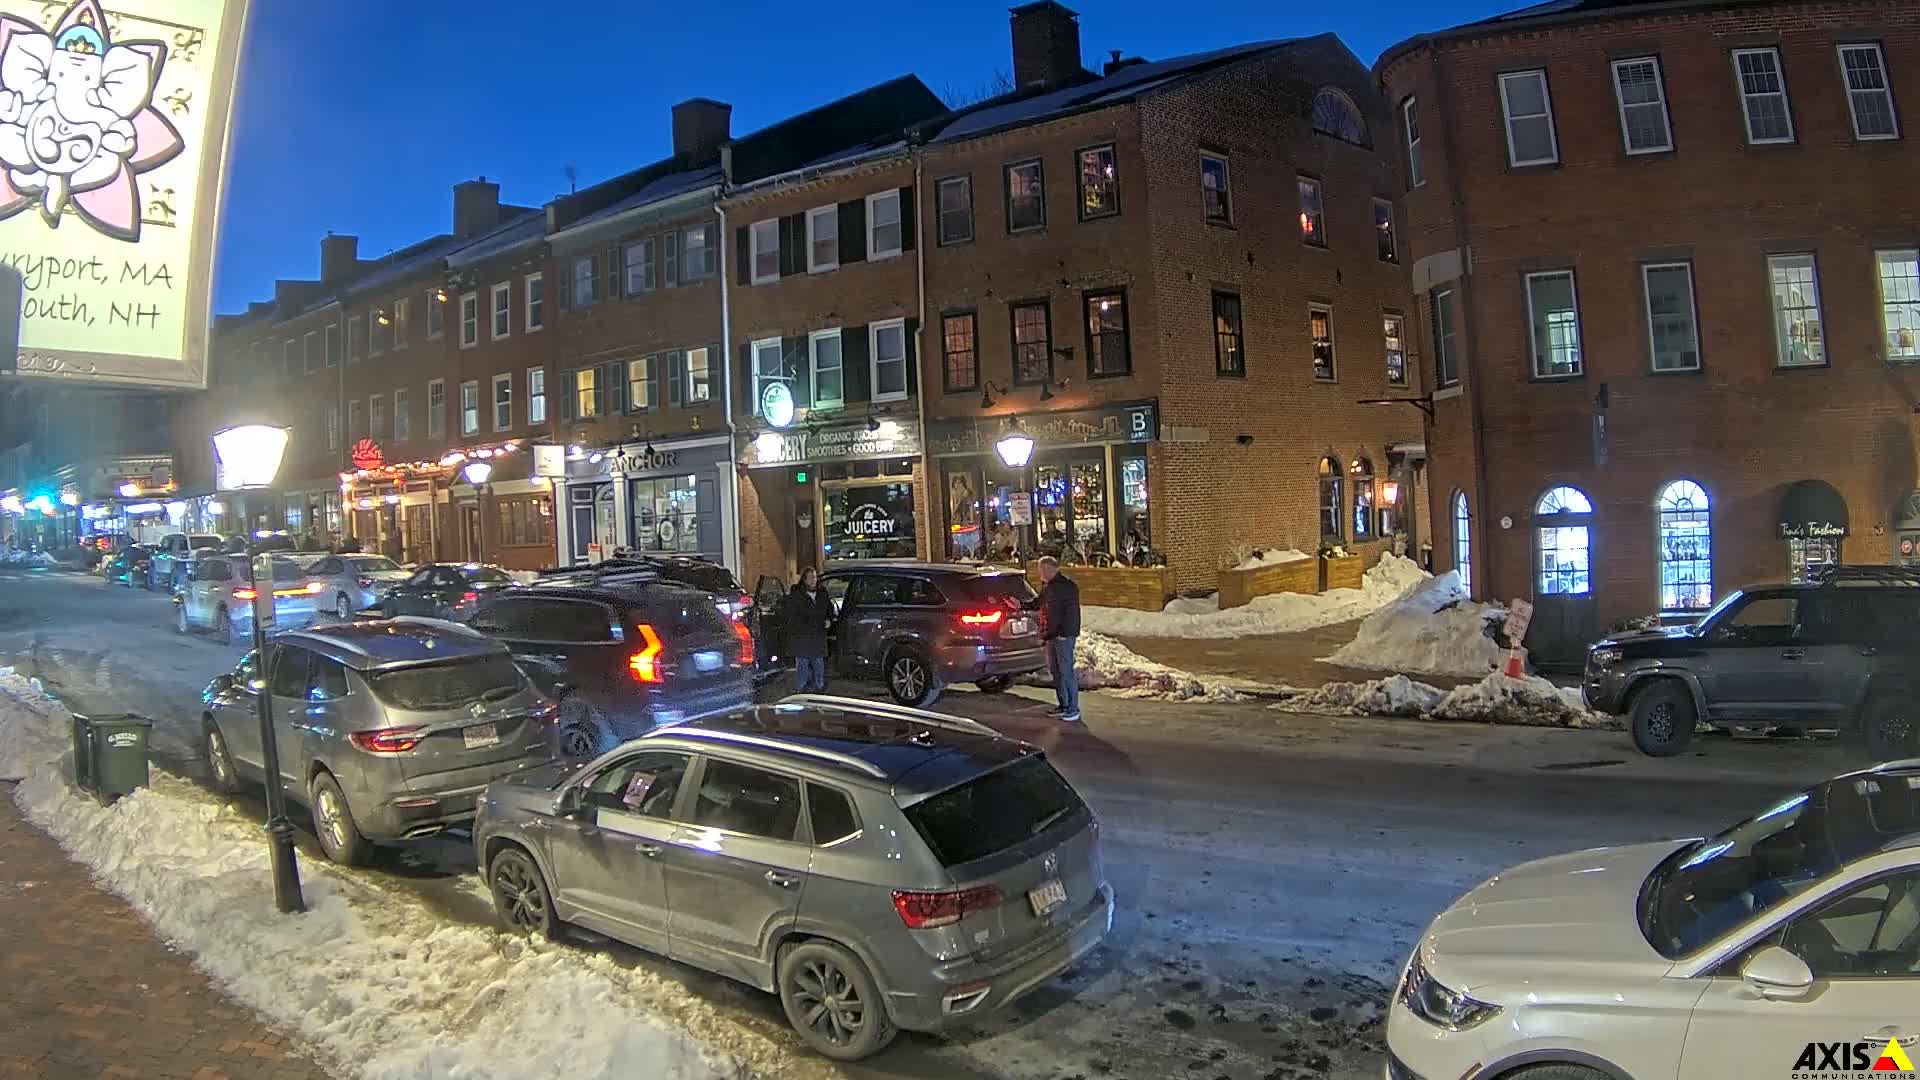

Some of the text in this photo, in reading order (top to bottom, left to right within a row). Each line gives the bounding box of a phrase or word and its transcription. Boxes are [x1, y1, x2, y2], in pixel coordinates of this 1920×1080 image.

[119, 260, 173, 290] MA
[109, 301, 161, 330] NH
[819, 432, 850, 444] ORGANIC
[807, 445, 846, 457] SMOOTHIES
[852, 442, 875, 454] GOOD
[611, 451, 677, 473] ANCHOR
[844, 518, 895, 535] JUICERY
